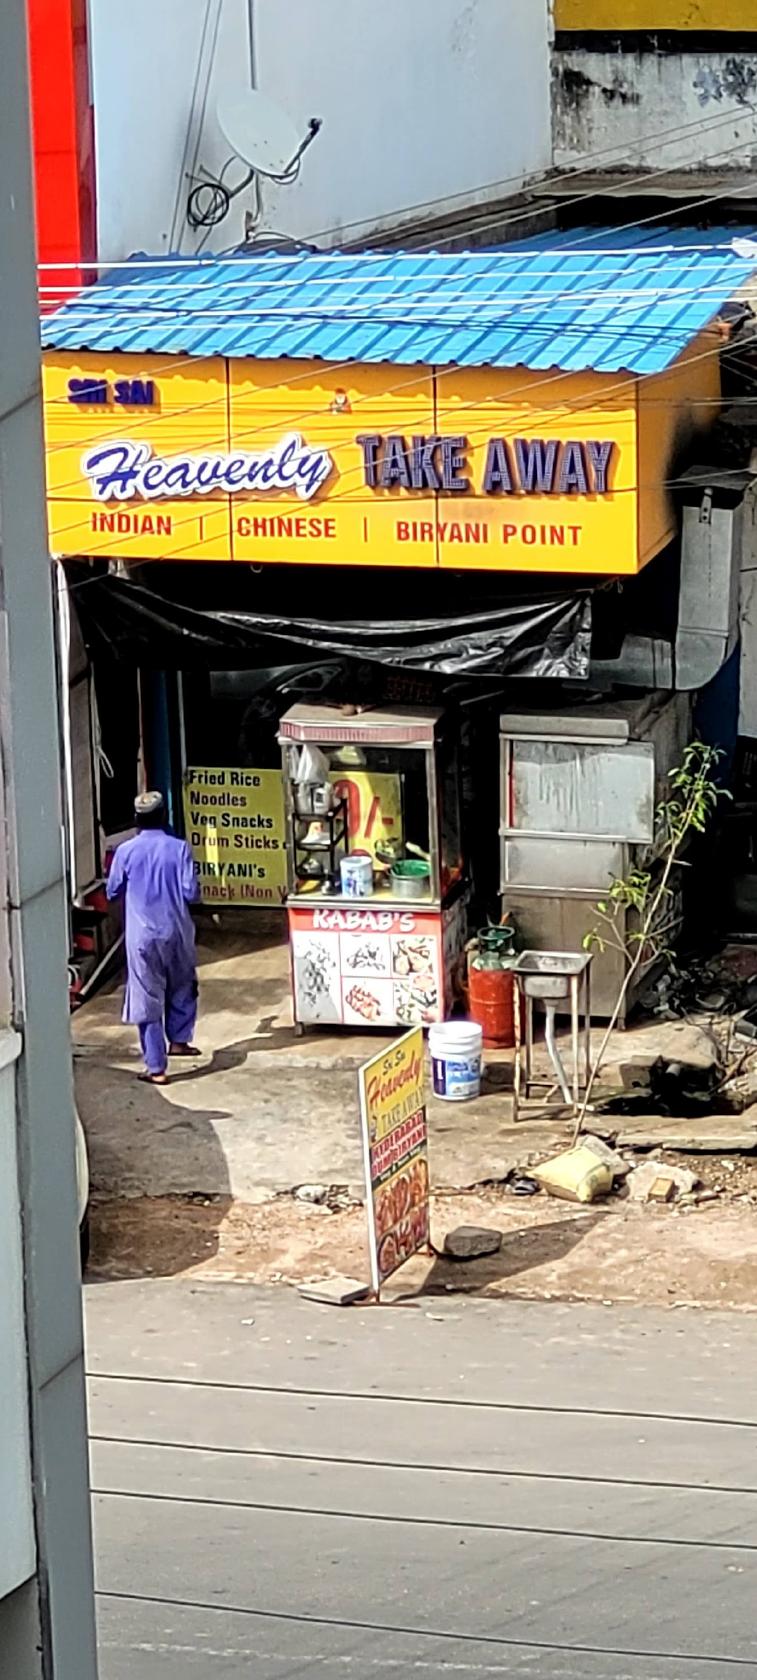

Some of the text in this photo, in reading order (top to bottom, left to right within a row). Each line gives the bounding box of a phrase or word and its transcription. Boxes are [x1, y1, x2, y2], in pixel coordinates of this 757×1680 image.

[114, 379, 155, 405] SAI
[83, 434, 615, 498] Heavenly TAKE AWAY
[91, 512, 582, 546] INDIAN CHINESE BIRYANI POINT
[189, 770, 261, 786] Fried Rice
[190, 791, 247, 806] Noodles
[190, 812, 273, 828] Veg Snacks
[191, 832, 229, 847] Drum
[234, 835, 279, 849] Sticks
[193, 861, 266, 878] BIRYANI's
[198, 882, 235, 899] nack
[312, 910, 416, 932] KABAB'S
[367, 1049, 421, 1110] Heavenly
